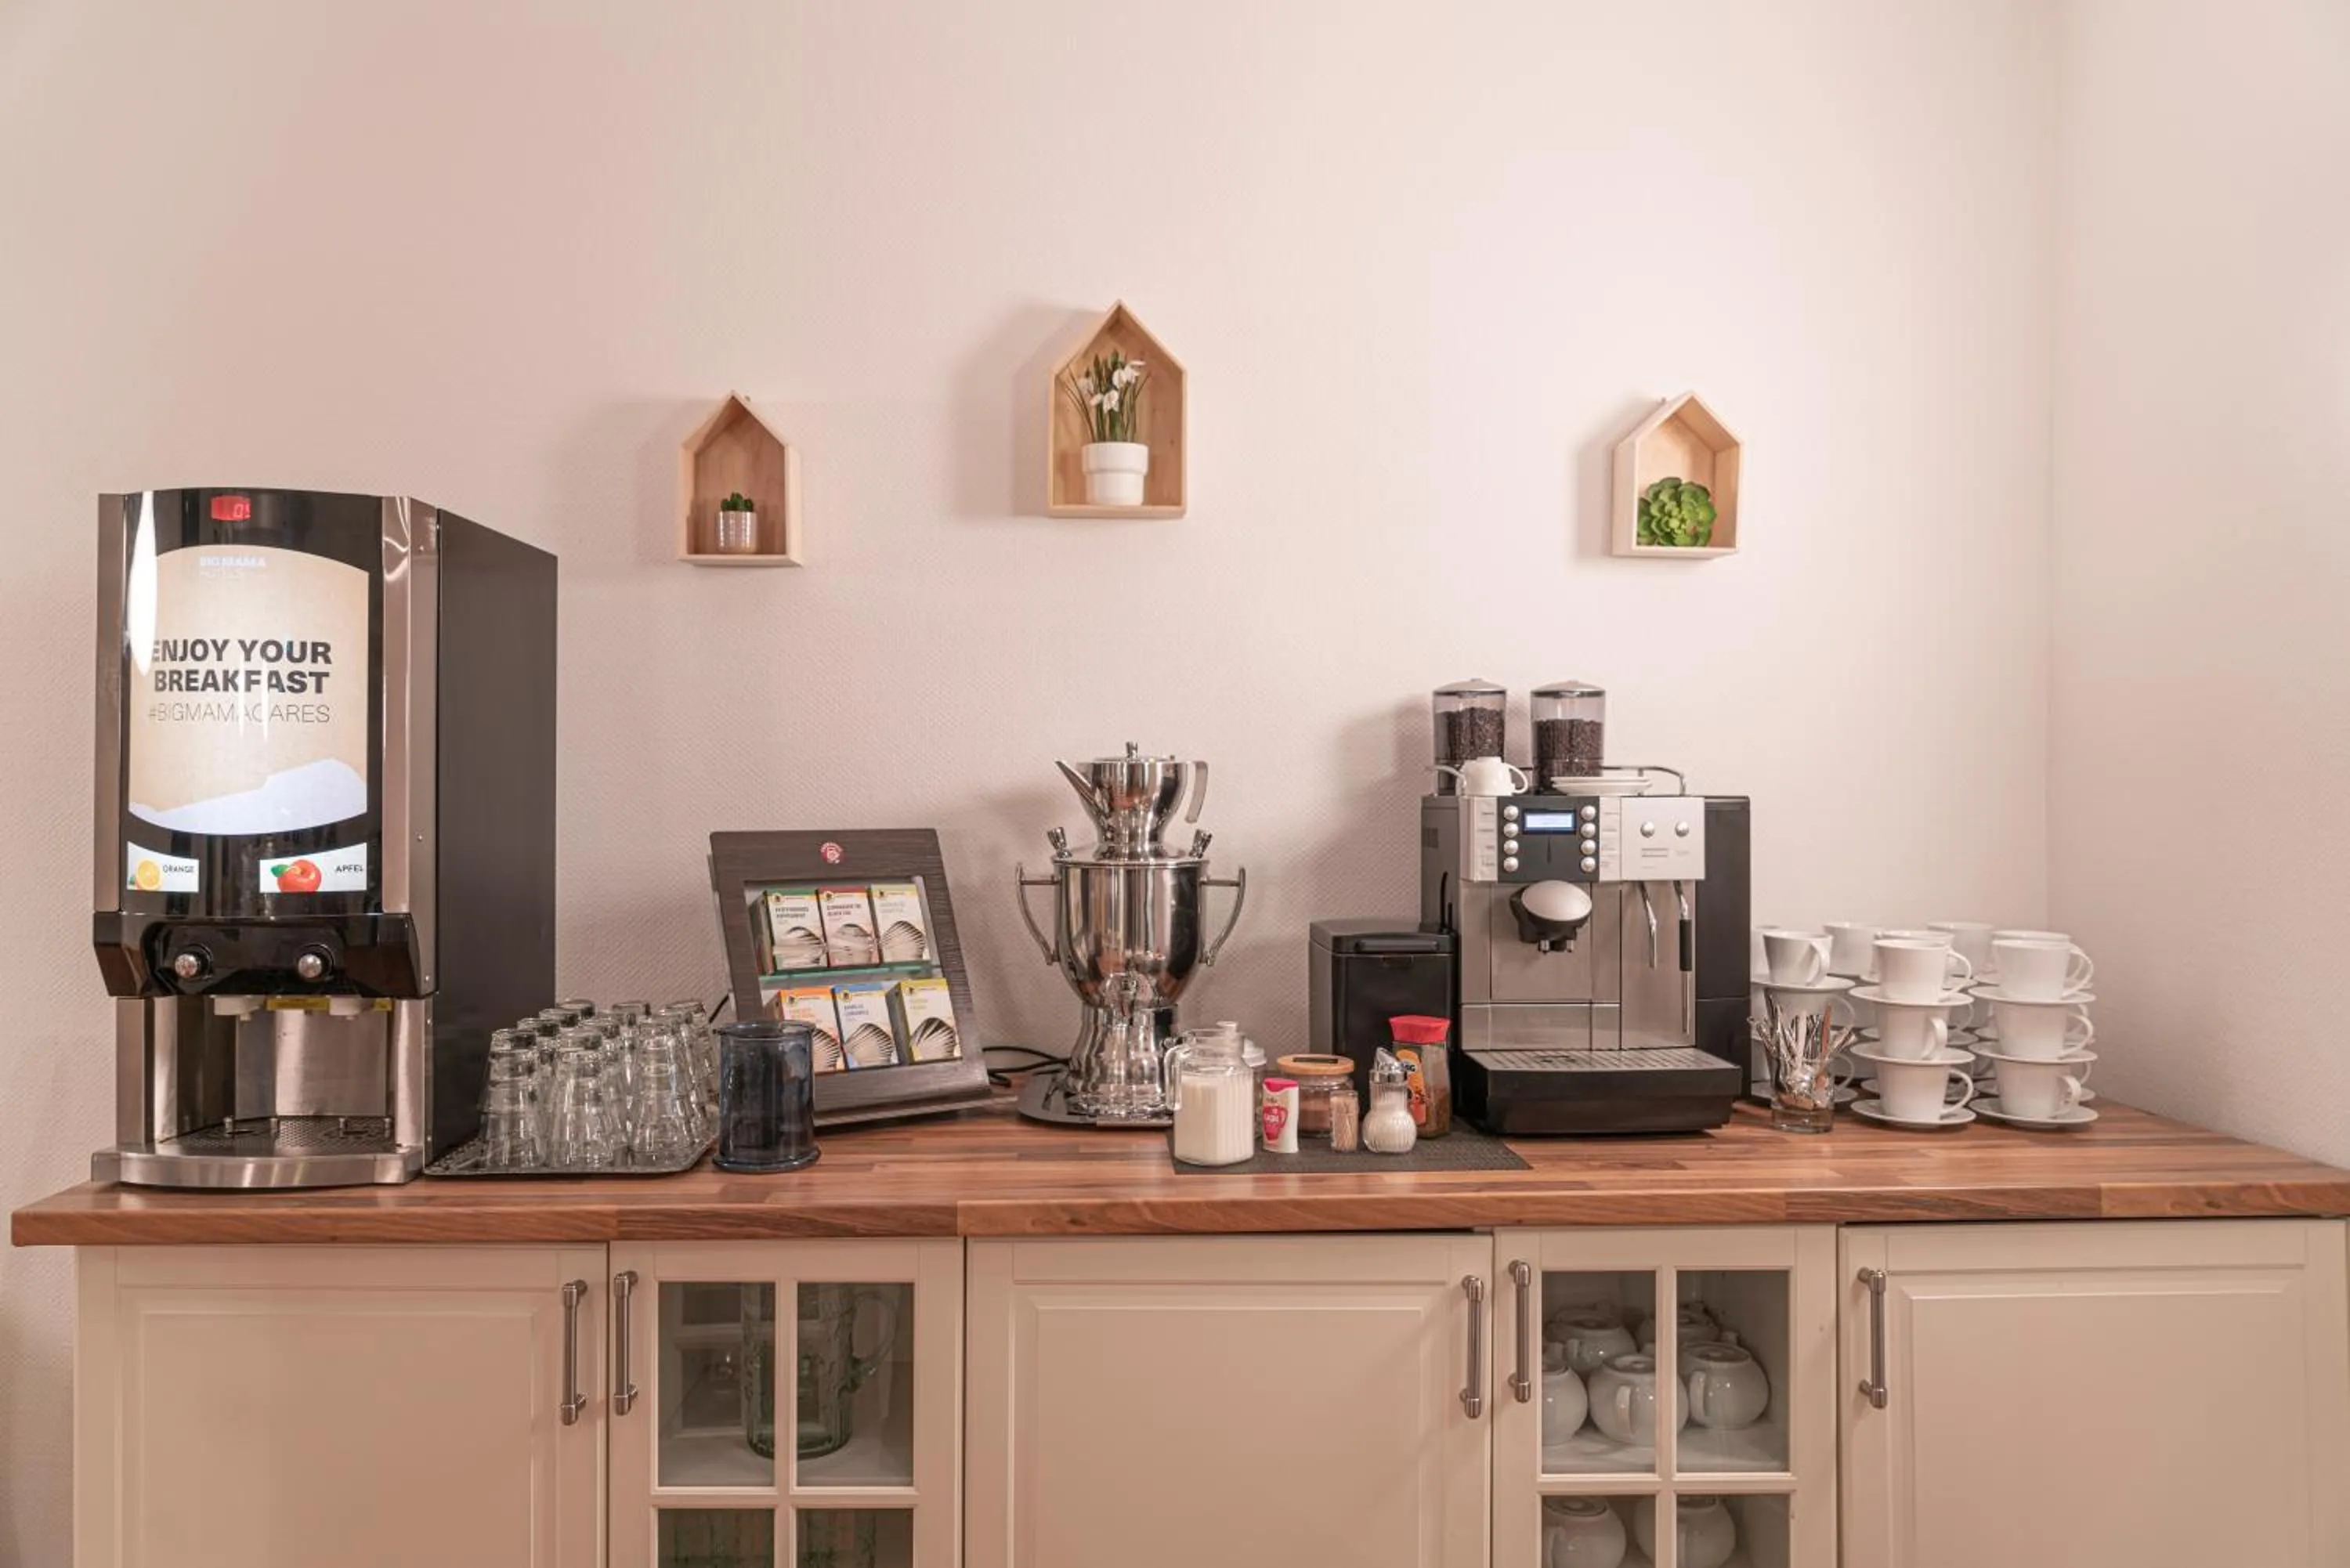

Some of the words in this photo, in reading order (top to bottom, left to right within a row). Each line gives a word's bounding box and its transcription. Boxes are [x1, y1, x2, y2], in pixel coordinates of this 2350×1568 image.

[153, 638, 230, 662] ENJOY
[237, 638, 332, 665] YOUR
[154, 669, 330, 694] BREAKFAST
[163, 864, 194, 873] ORANGE
[336, 864, 363, 873] APFEL
